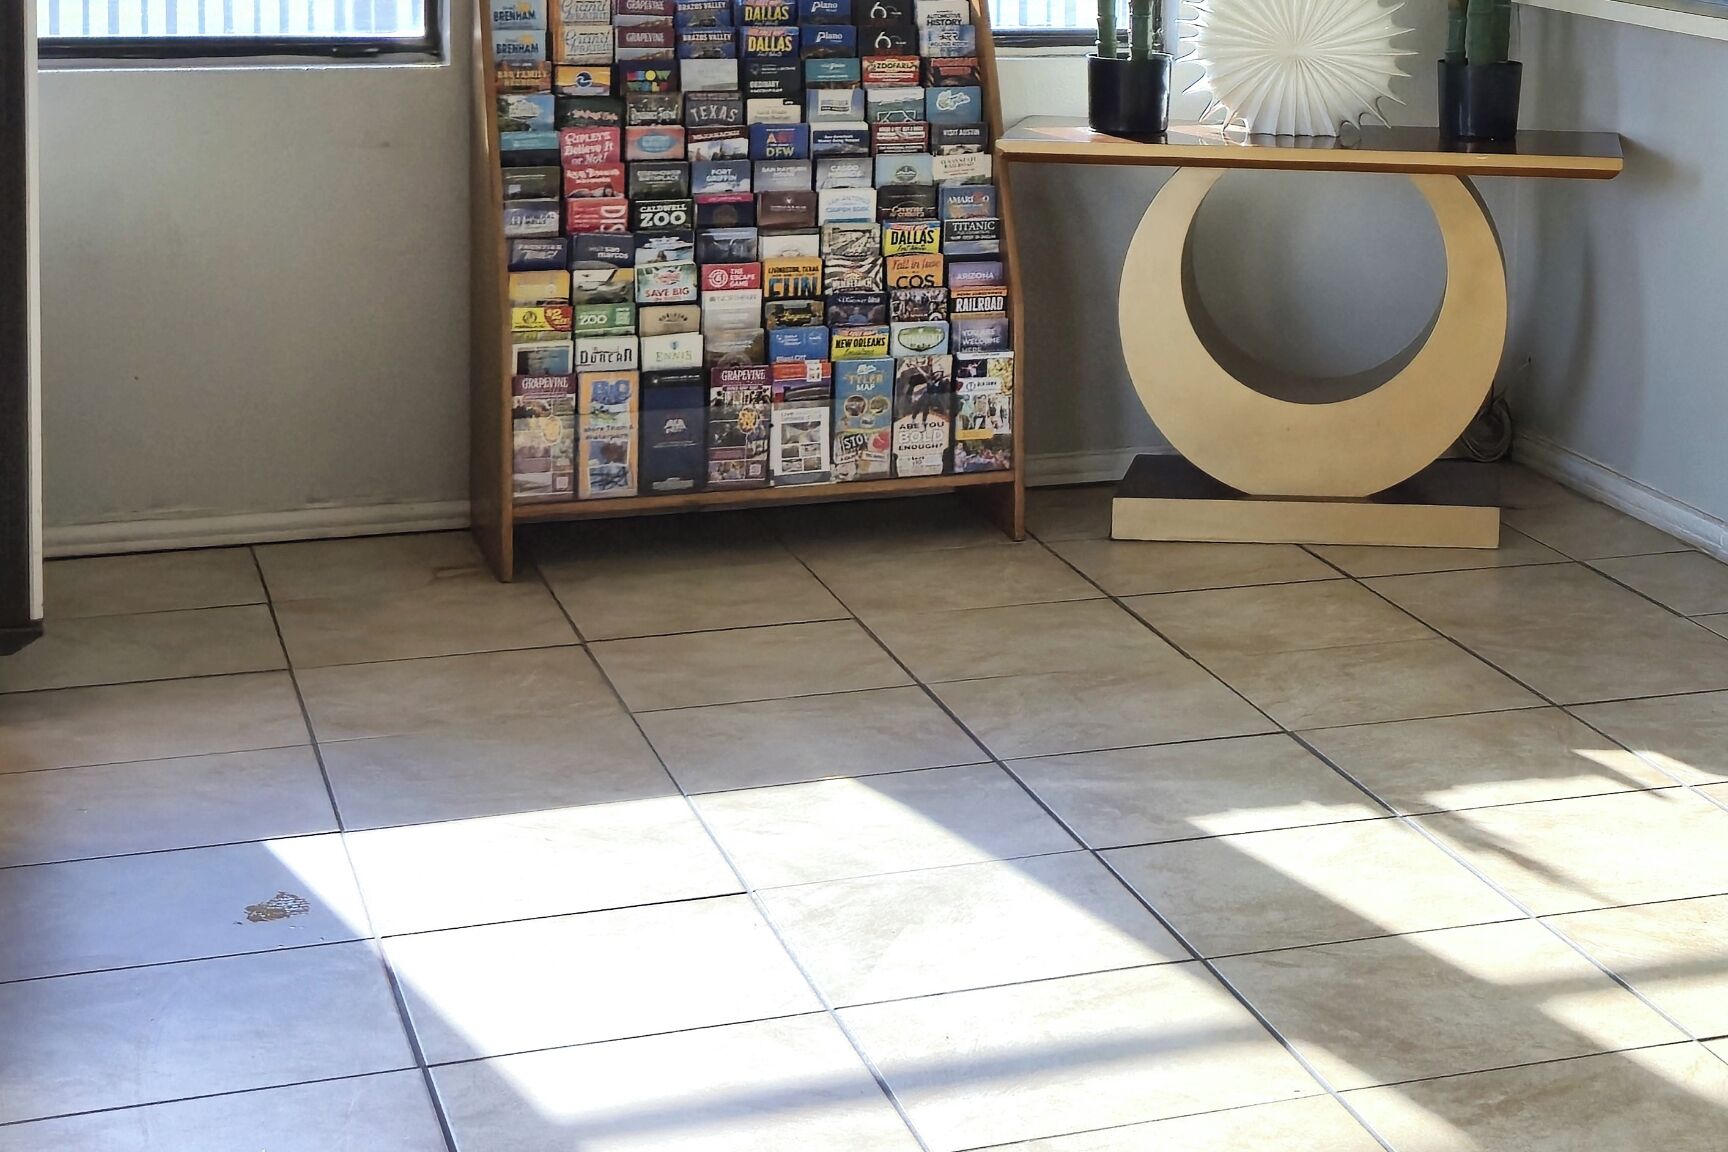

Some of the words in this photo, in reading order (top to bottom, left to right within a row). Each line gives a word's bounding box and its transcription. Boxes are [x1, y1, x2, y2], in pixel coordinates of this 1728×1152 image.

[811, 1, 838, 13] Plano
[493, 10, 536, 22] BRENHAM
[745, 6, 789, 21] DALLAS
[926, 19, 962, 27] HISTORY
[626, 32, 664, 43] GRAPEVINE
[708, 33, 732, 42] VALLEY
[816, 31, 843, 43] Plano
[496, 42, 539, 55] BRENHAM
[748, 36, 793, 52] DALLAS
[690, 104, 738, 122] TEXAS
[766, 147, 794, 157] DFW
[640, 203, 687, 212] CALDWELL
[640, 211, 686, 227] ZOO
[952, 221, 995, 231] TITANIC
[891, 229, 934, 245] DALLAS
[645, 288, 669, 298] SAVE
[672, 287, 690, 296] BIG
[768, 276, 818, 298] FUN
[956, 296, 1003, 312] RAILROAD
[579, 314, 608, 325] ZOO
[835, 339, 852, 348] NEW
[853, 337, 885, 347] ORLEANS
[656, 351, 692, 362] ENNIS
[721, 369, 766, 381] GRAPEVINE
[522, 376, 569, 389] GRAPEVINE
[923, 421, 944, 429] YOU
[899, 429, 944, 444] BOLD
